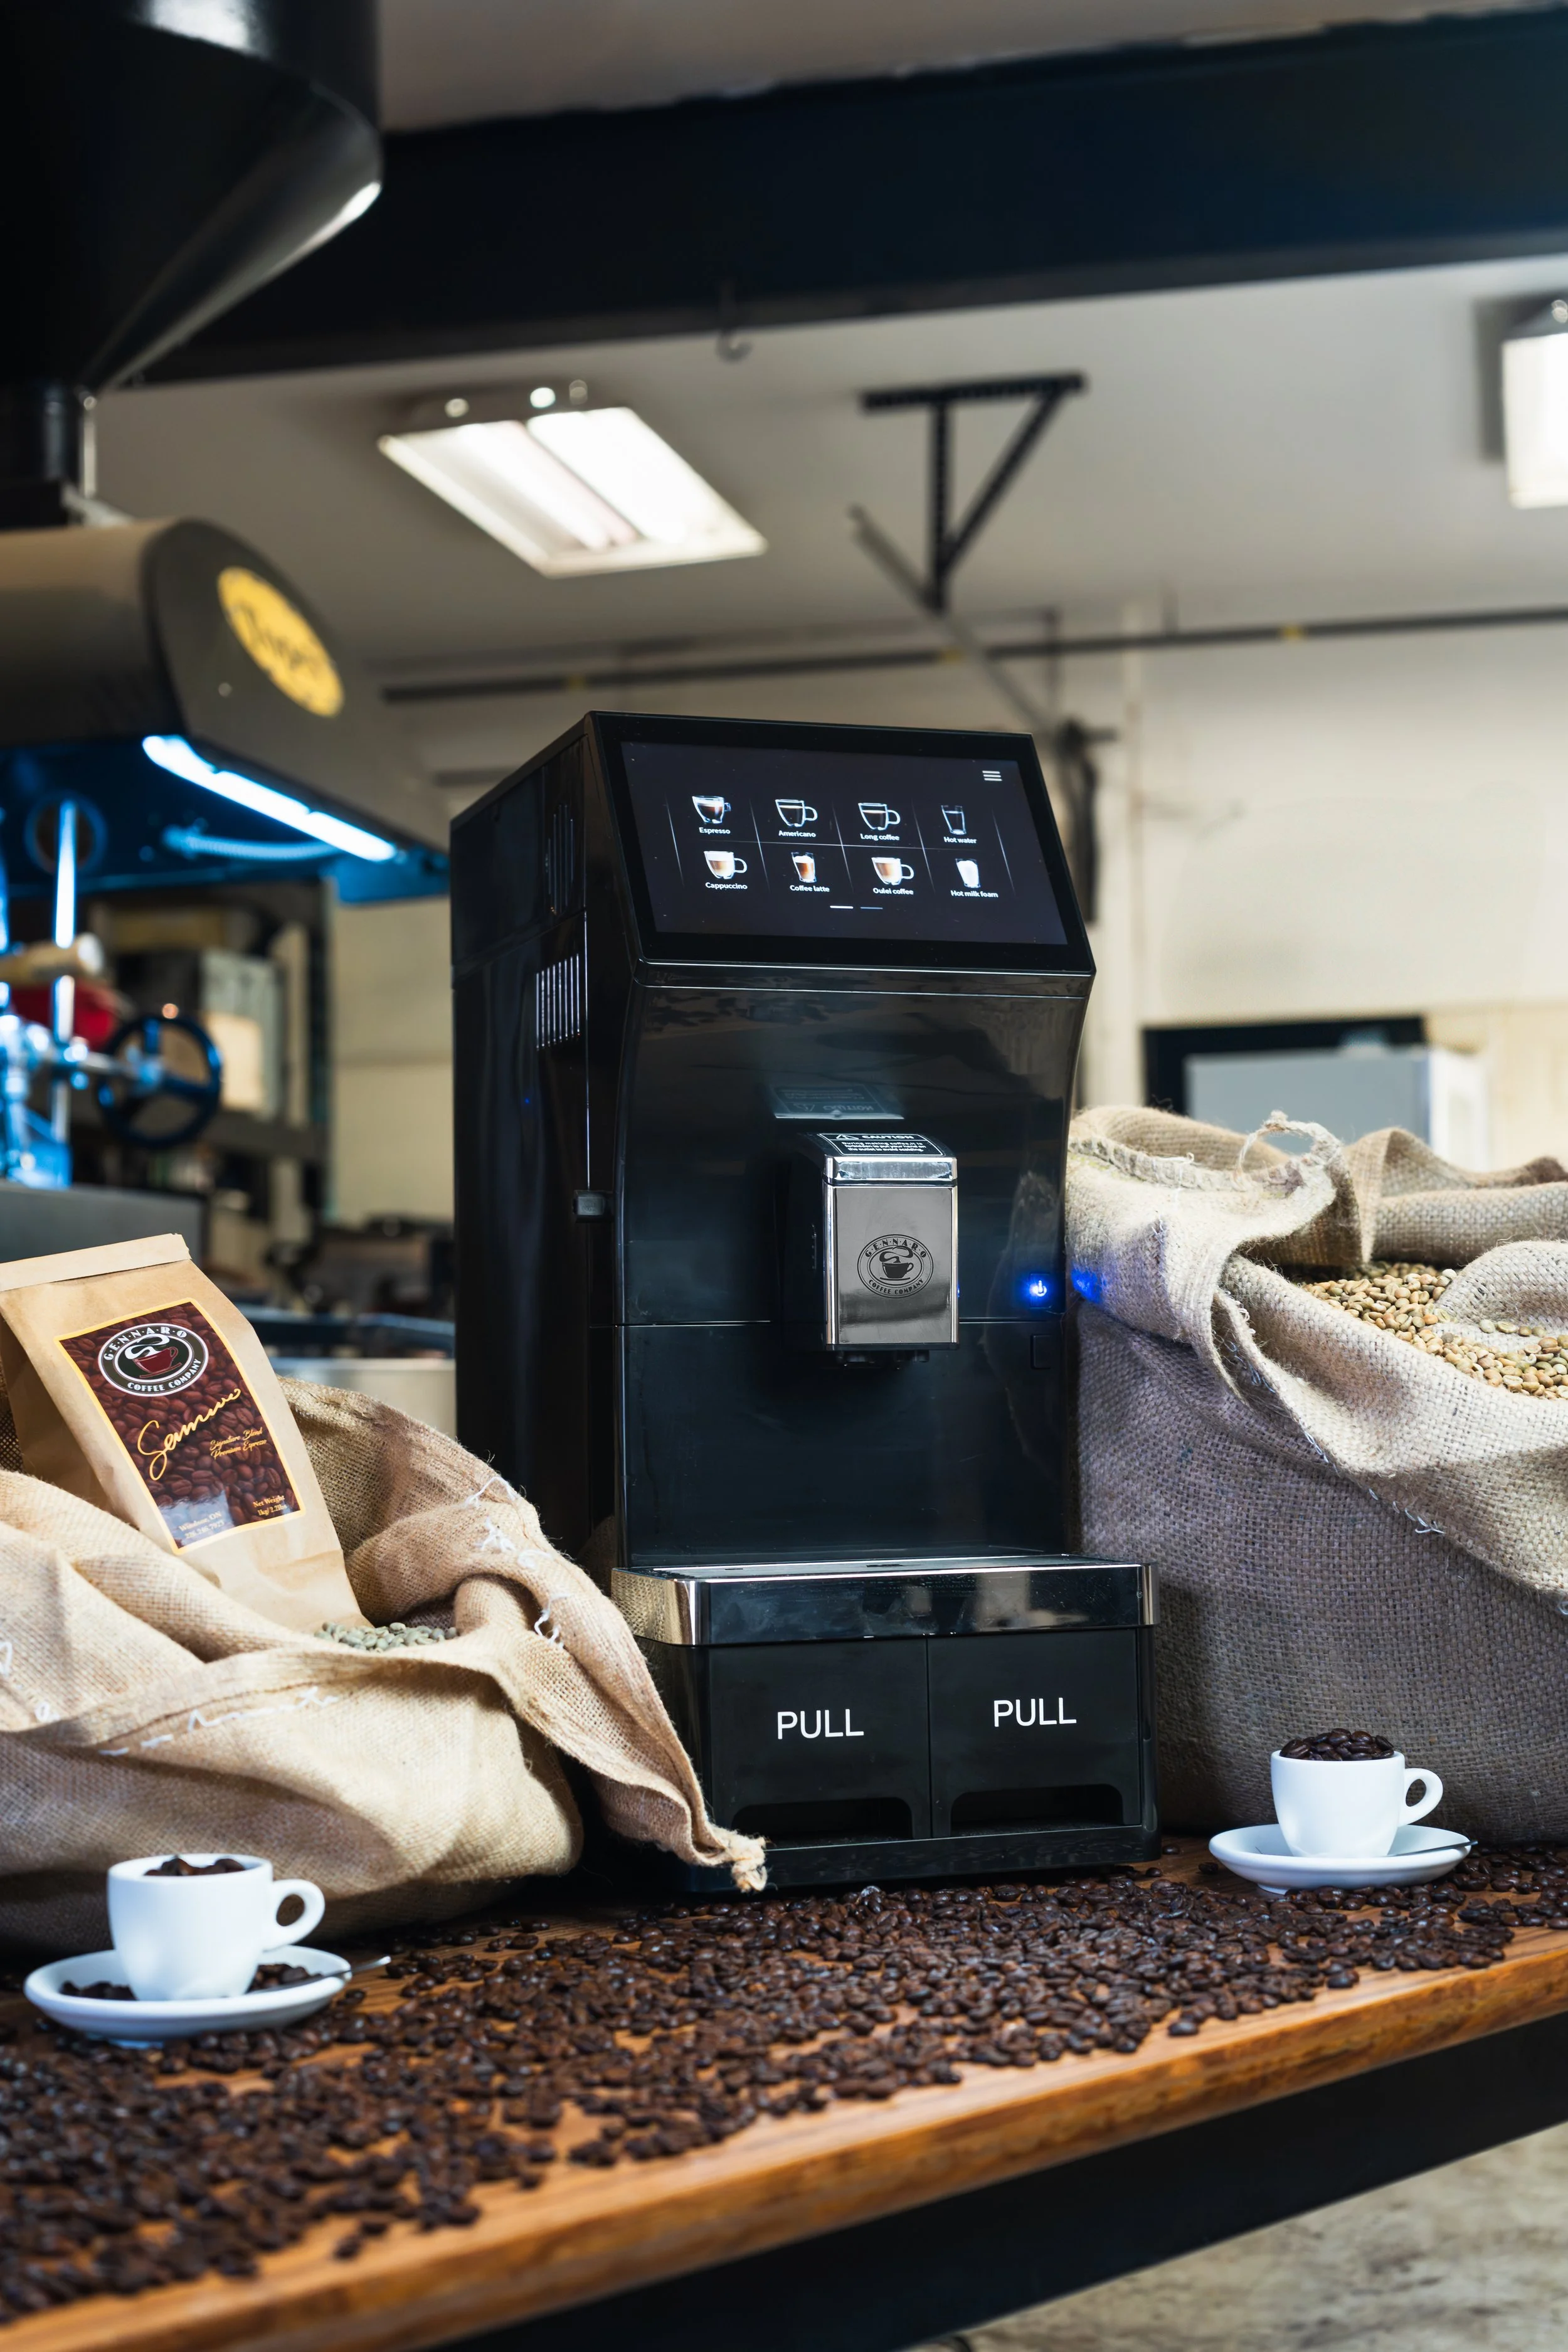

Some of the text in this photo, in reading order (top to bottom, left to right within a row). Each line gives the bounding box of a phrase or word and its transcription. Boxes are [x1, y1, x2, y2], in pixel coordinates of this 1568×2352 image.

[860, 833, 878, 841] Long
[706, 882, 748, 890] Cappuccino
[869, 1278, 923, 1295] COFFEE COMPANY
[127, 1359, 201, 1392] COFFEE COMPANY
[209, 1427, 263, 1451] Signature Blend
[210, 1446, 241, 1460] Premium
[265, 1495, 285, 1505] Weight
[208, 1510, 222, 1521] ON
[993, 1697, 1077, 1727] PULL
[777, 1708, 864, 1740] PULL
